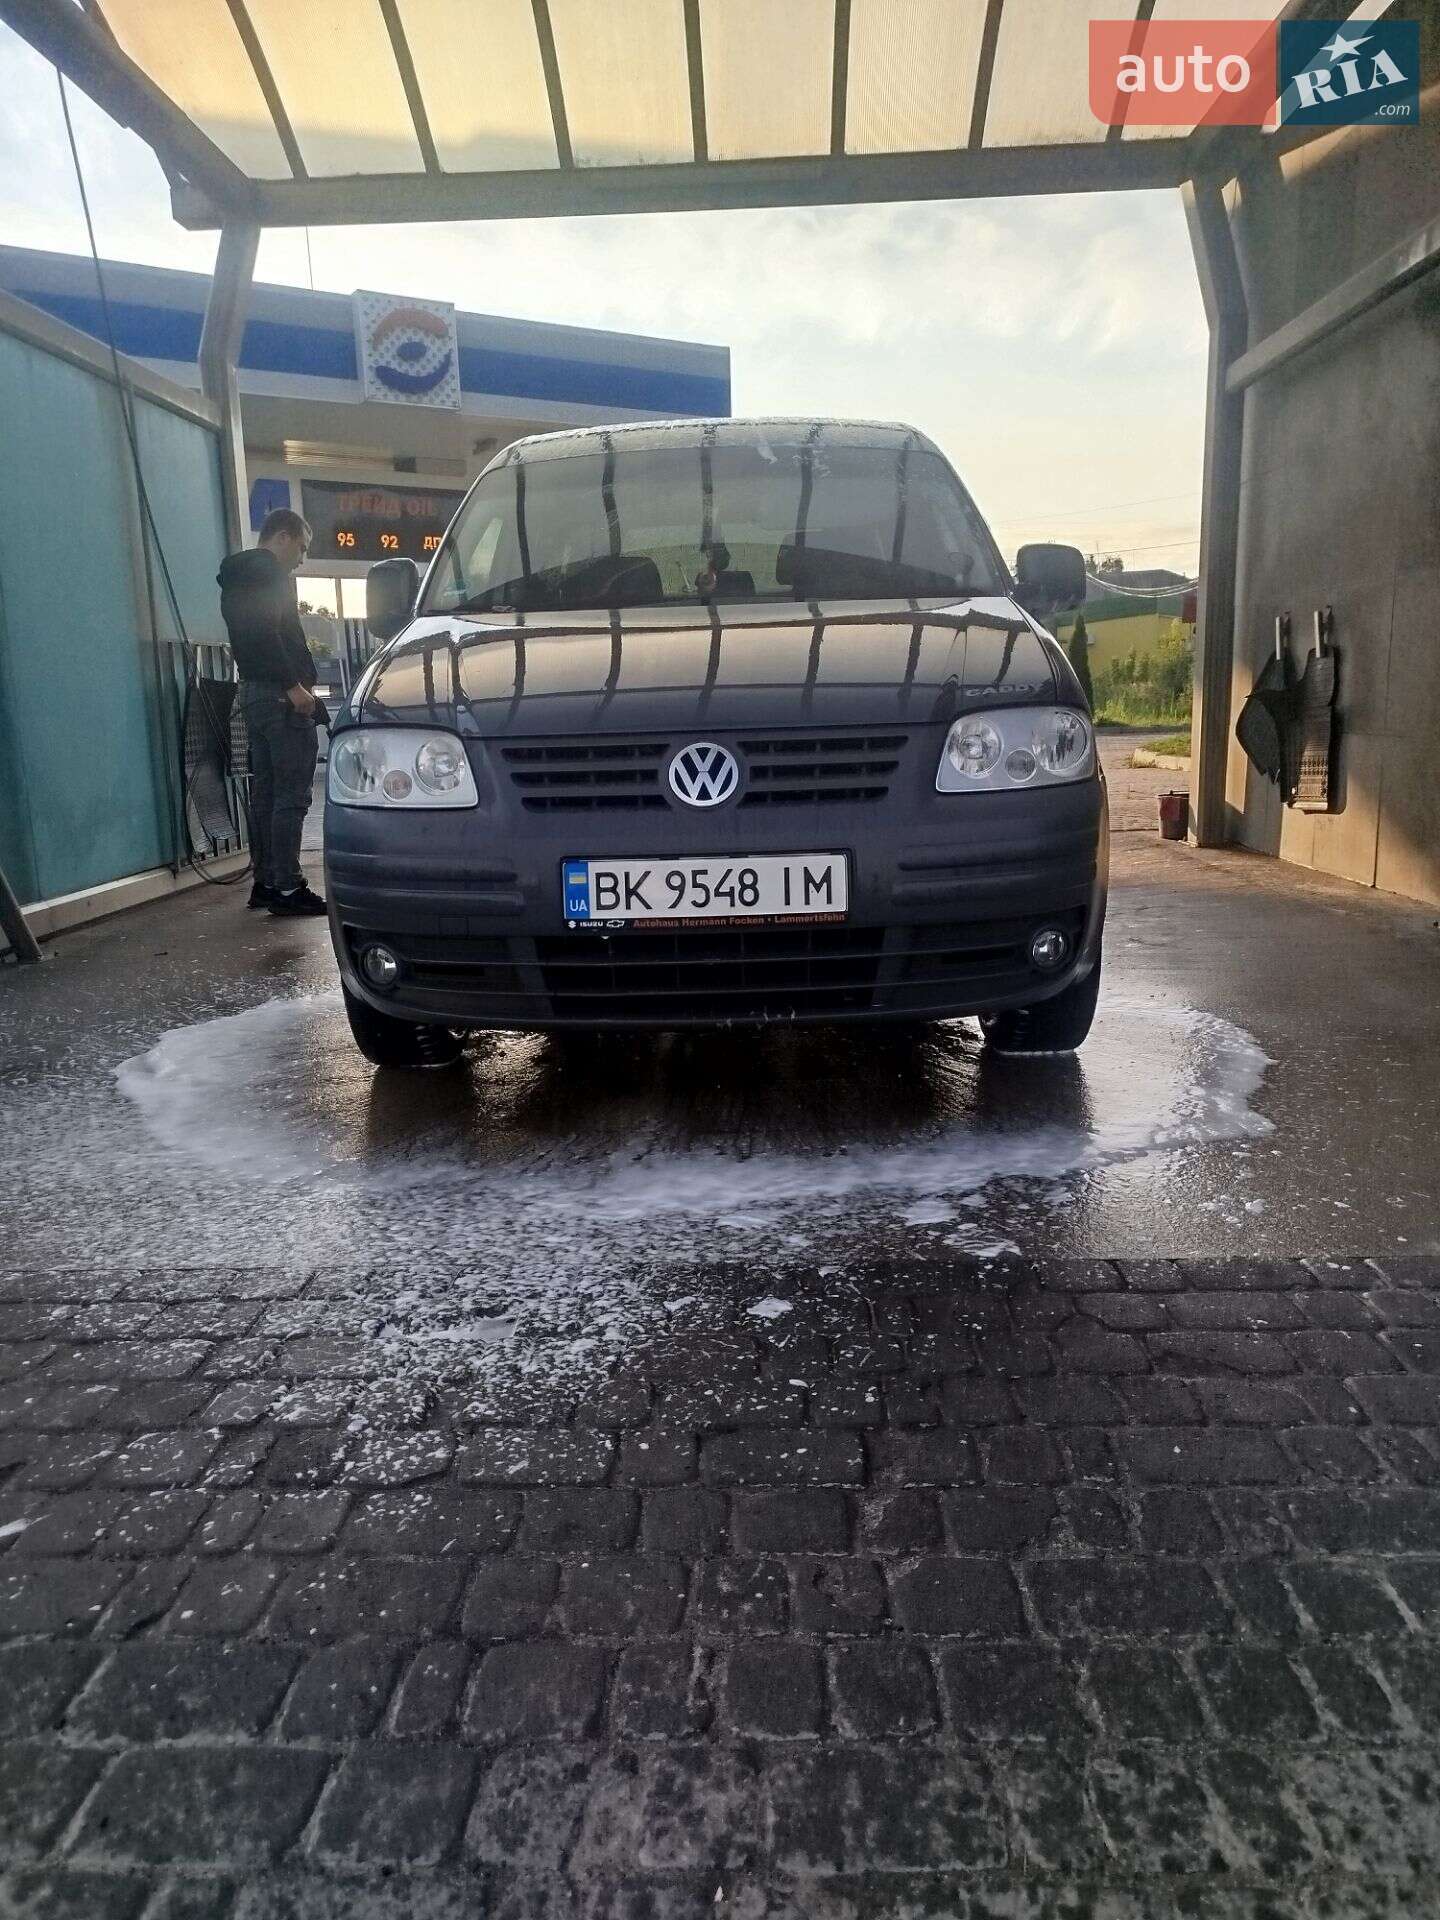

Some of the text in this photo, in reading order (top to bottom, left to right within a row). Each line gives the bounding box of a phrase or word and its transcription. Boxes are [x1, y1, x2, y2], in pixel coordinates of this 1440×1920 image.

[337, 532, 355, 547] 95
[380, 534, 399, 549] 92
[594, 865, 833, 911] BK 9548 IM
[569, 898, 588, 912] UA
[633, 919, 679, 928] Autohaus
[681, 917, 727, 927] Hermann
[729, 916, 765, 926] Focken
